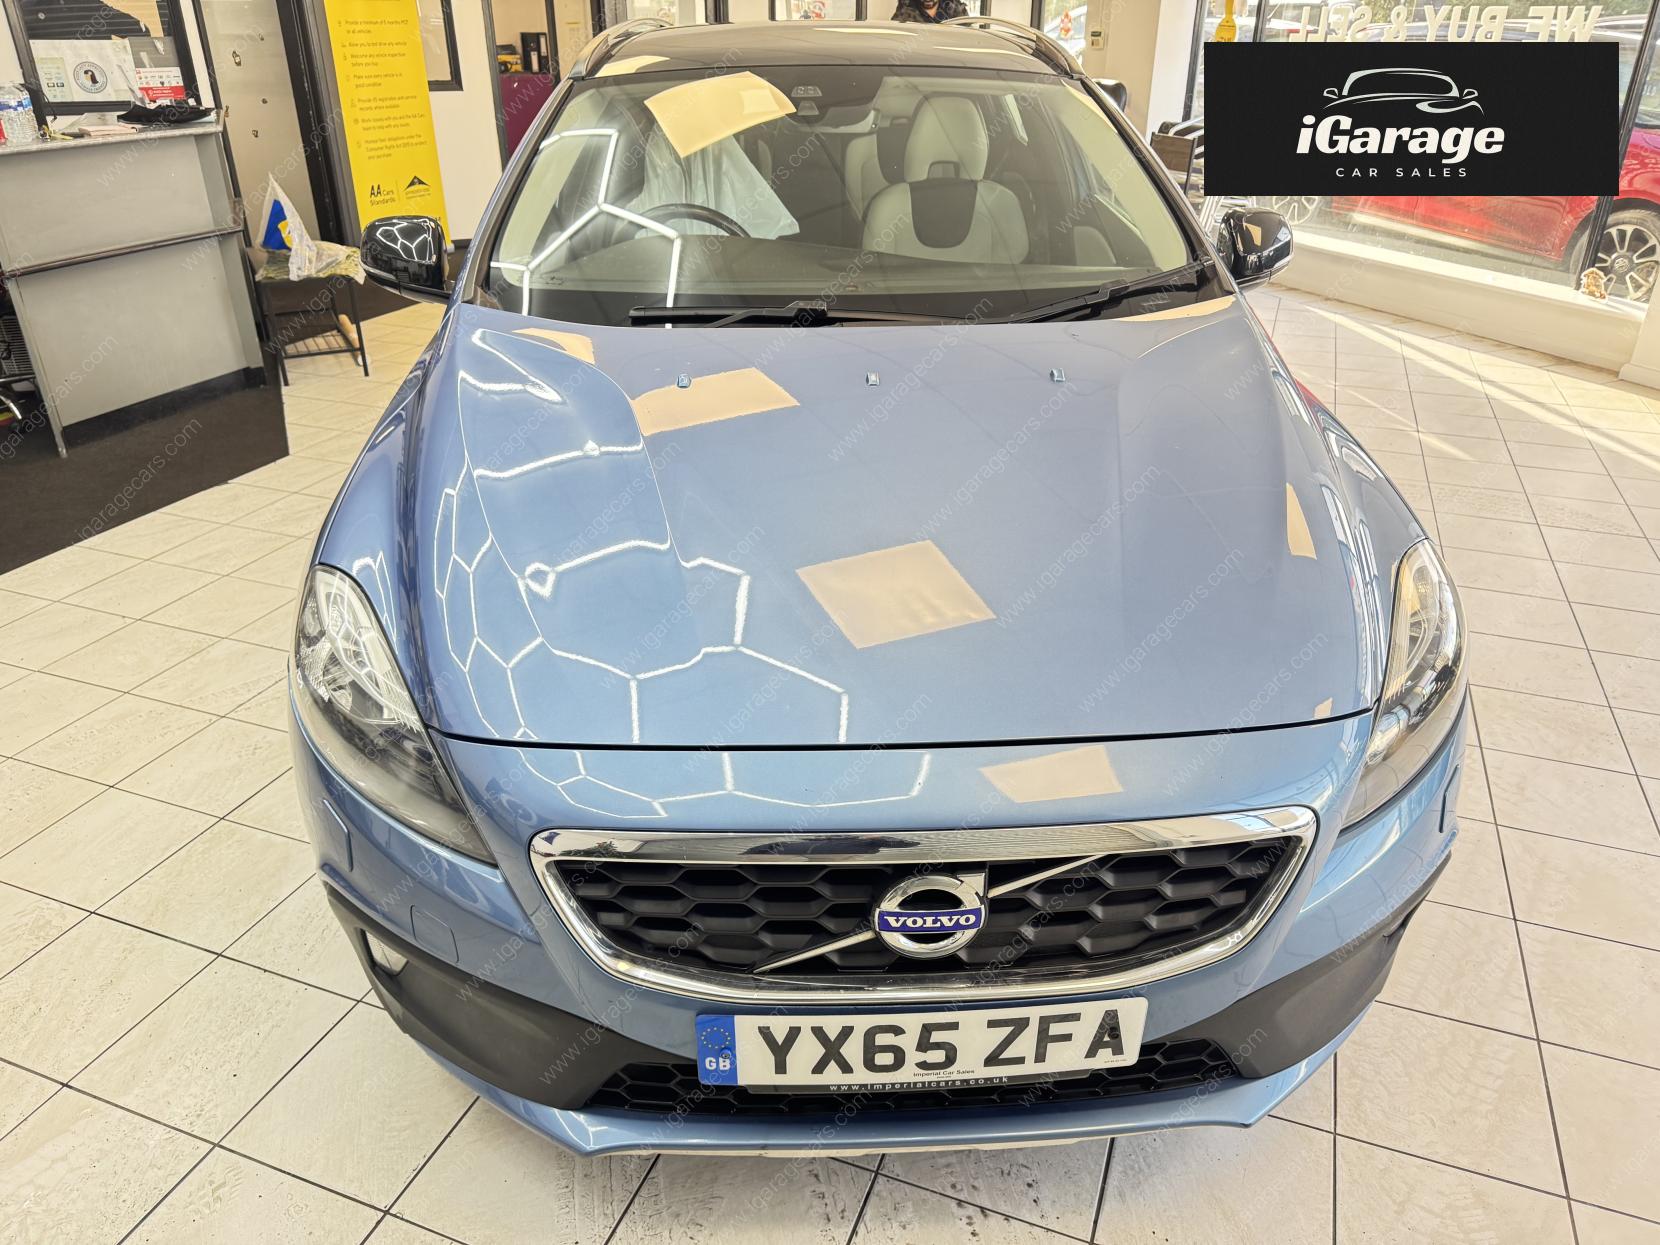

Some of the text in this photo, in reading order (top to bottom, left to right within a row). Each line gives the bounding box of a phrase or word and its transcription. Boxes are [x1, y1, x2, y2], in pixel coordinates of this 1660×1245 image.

[370, 184, 381, 198] AA
[884, 914, 976, 928] VOLVO
[757, 1009, 1125, 1075] YX65 ZFA
[705, 1057, 731, 1070] GB
[829, 1076, 1009, 1091] www.imperialcars.co.uk
